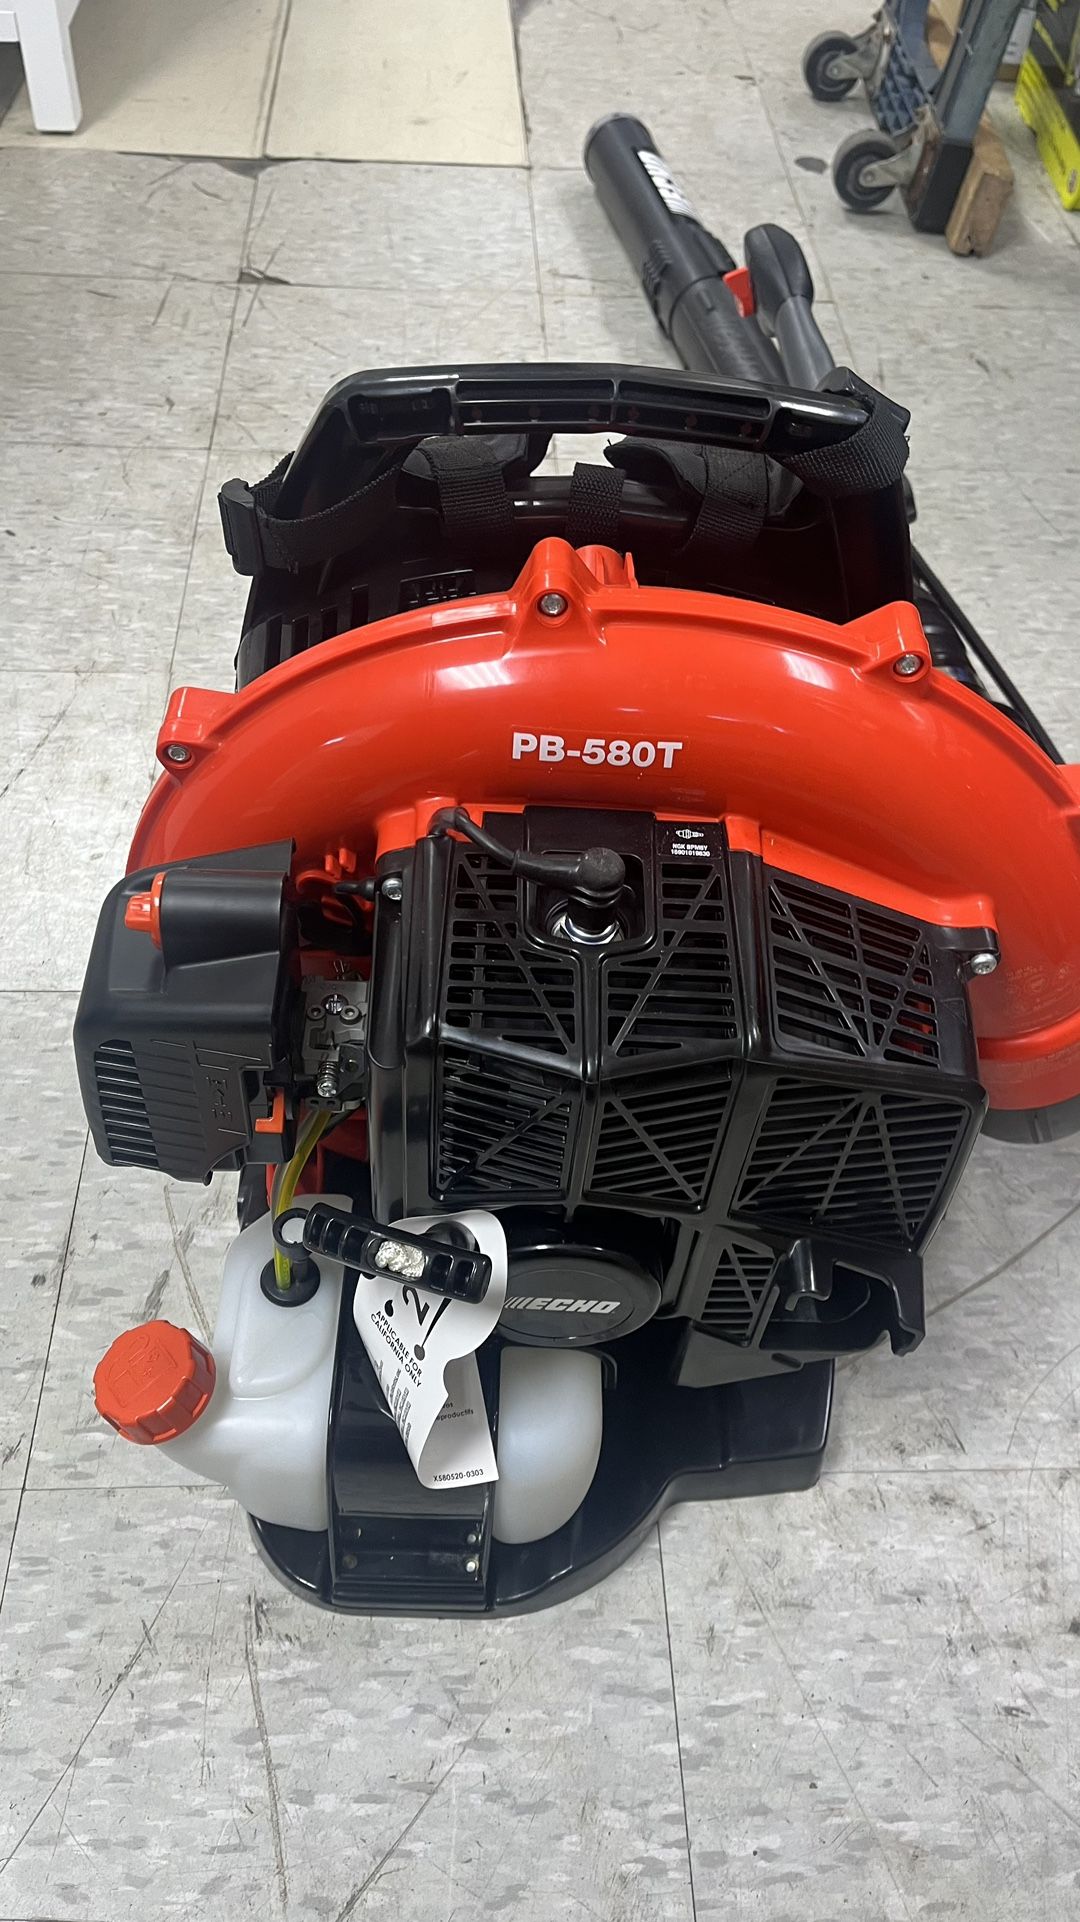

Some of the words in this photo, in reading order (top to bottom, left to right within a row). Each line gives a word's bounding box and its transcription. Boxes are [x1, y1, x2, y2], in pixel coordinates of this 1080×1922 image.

[512, 731, 683, 769] PB-580T
[525, 1297, 621, 1314] ECHO
[370, 1313, 404, 1365] CALIFORNIA
[404, 1363, 422, 1388] ONLY
[375, 1310, 410, 1360] APPLICABLE
[409, 1357, 422, 1378] FOR
